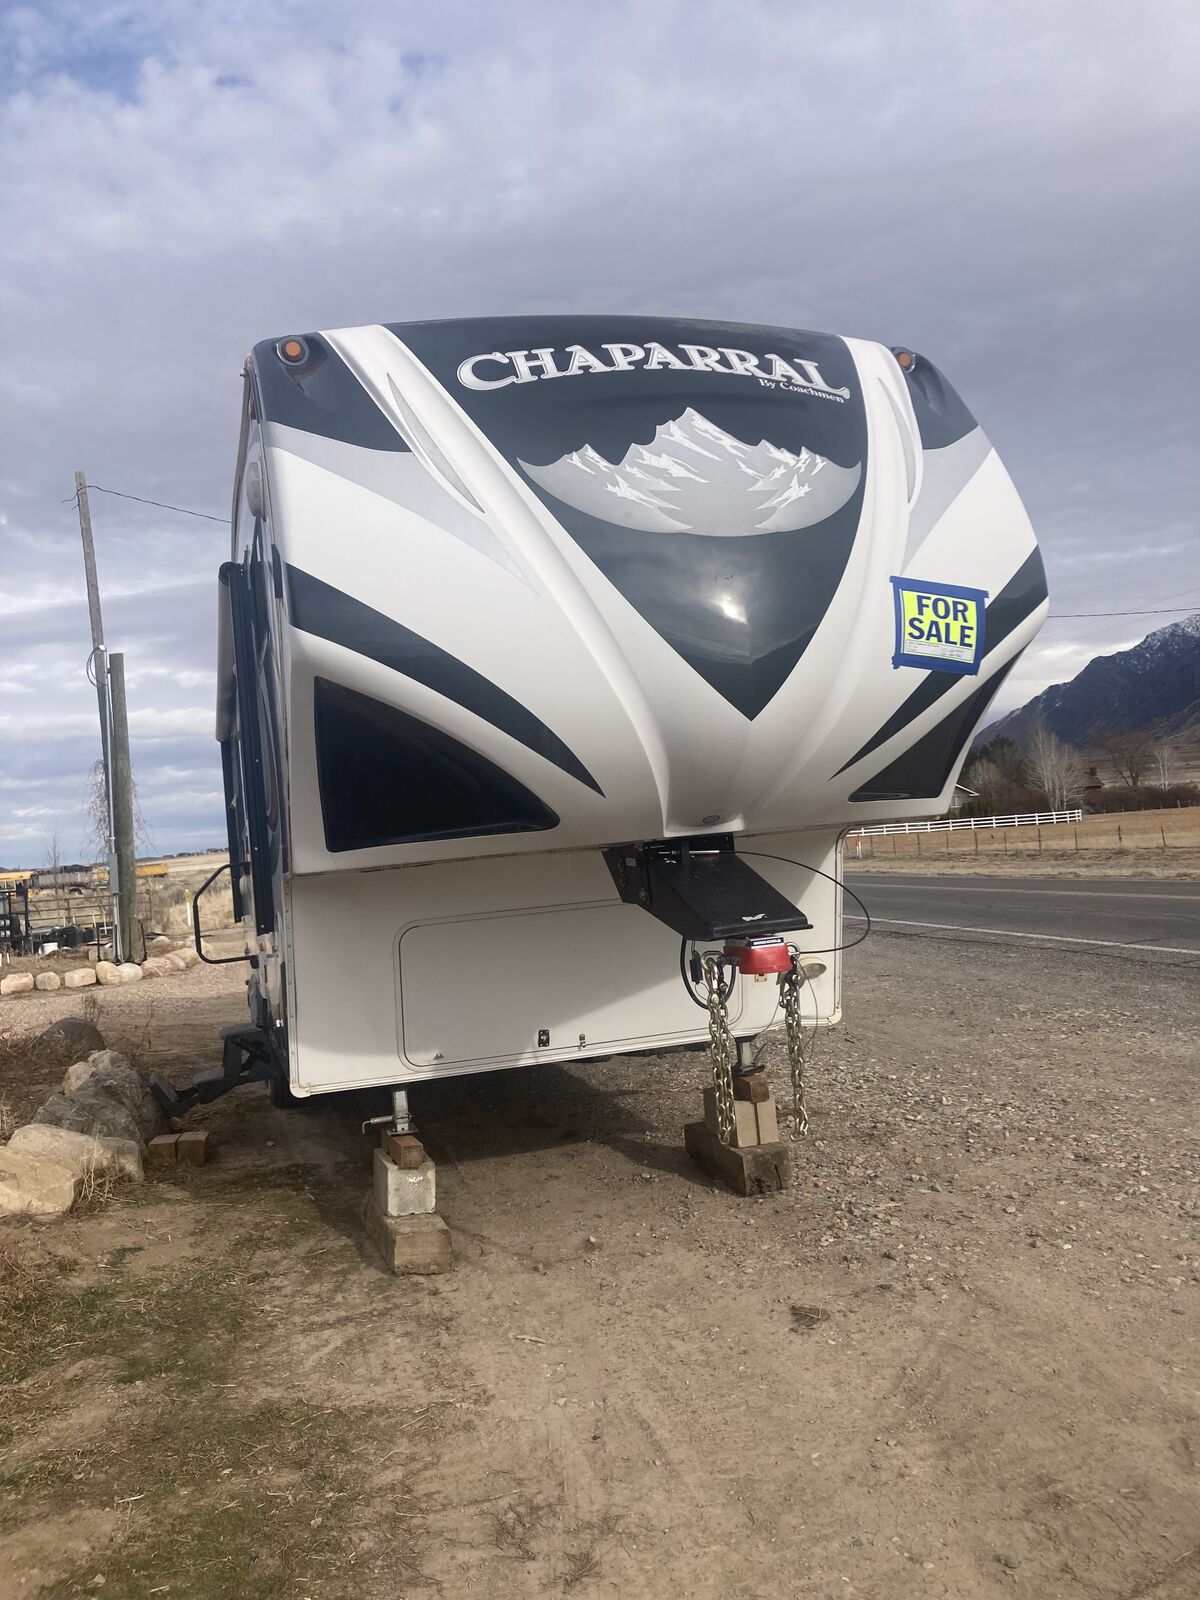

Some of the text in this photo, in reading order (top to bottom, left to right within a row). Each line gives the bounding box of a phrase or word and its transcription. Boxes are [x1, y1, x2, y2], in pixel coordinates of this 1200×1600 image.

[456, 341, 851, 399] CHAPARRAL
[759, 378, 845, 403] By Coachmen
[916, 594, 969, 623] FOR
[908, 617, 974, 648] SALE
